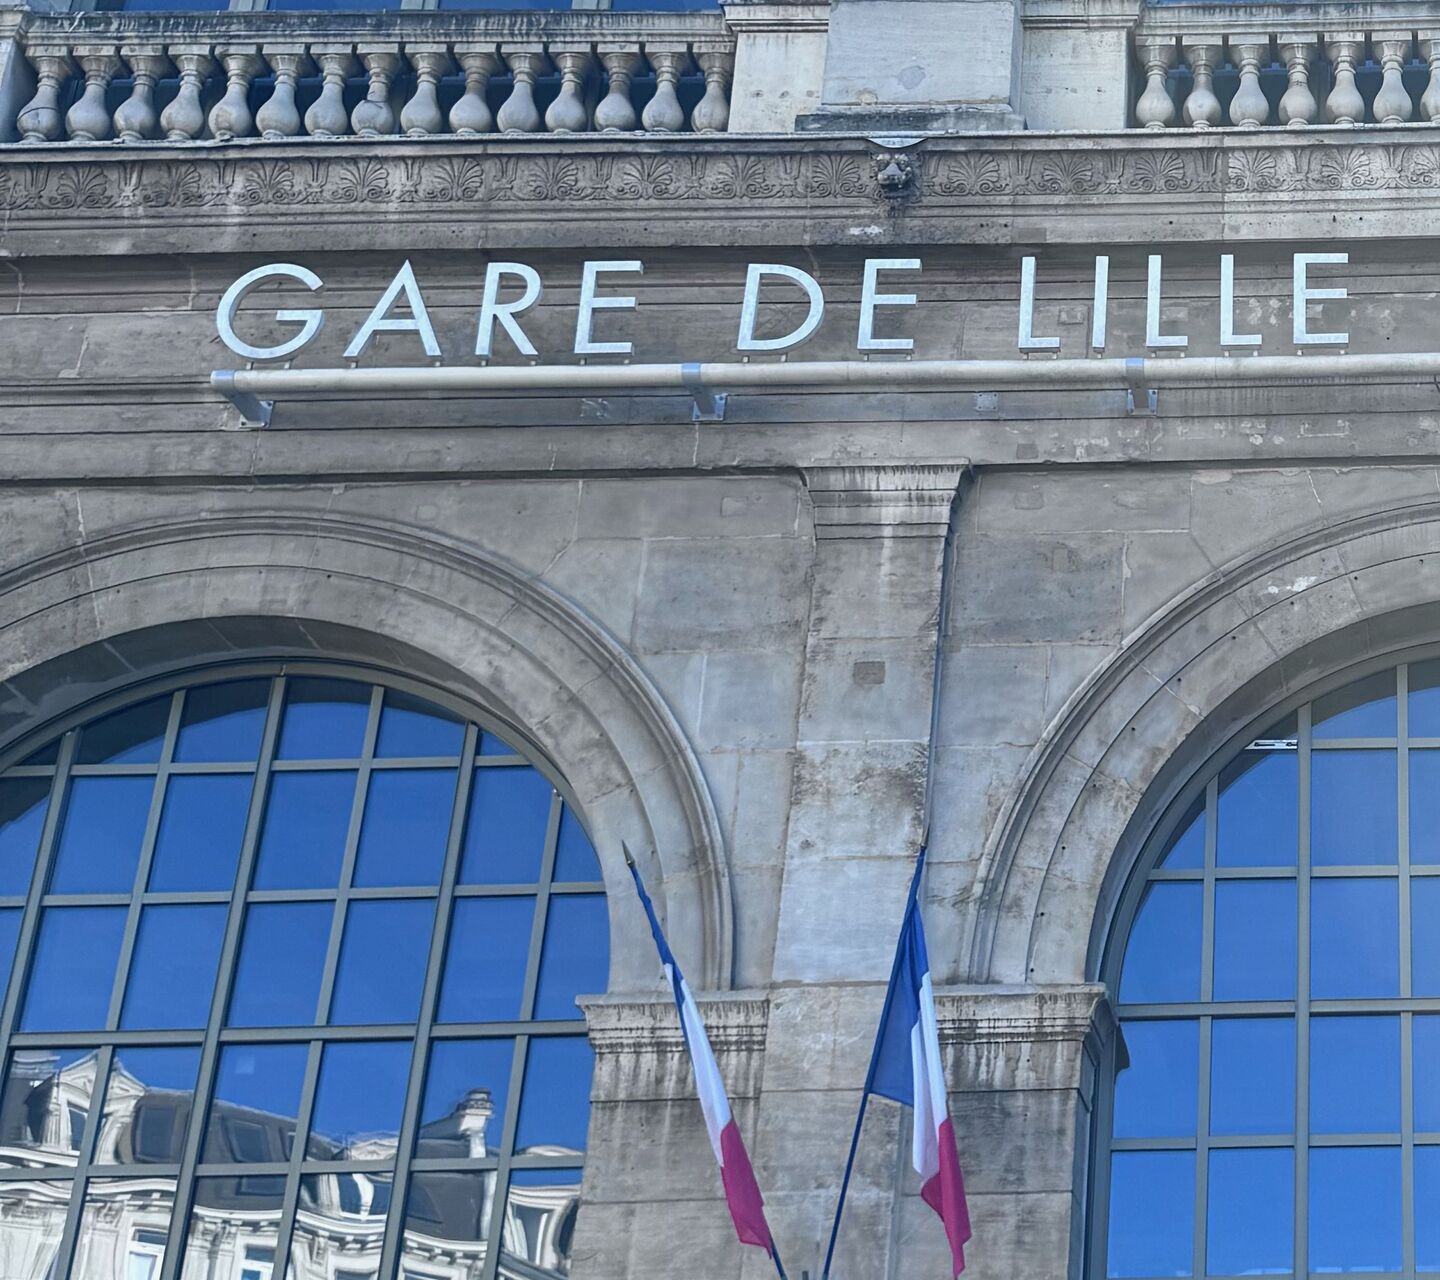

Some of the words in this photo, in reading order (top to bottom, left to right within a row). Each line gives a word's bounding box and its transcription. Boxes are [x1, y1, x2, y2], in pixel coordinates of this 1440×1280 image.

[214, 260, 645, 361] GARE
[736, 257, 923, 356] DE
[1018, 251, 1351, 354] LILLE
